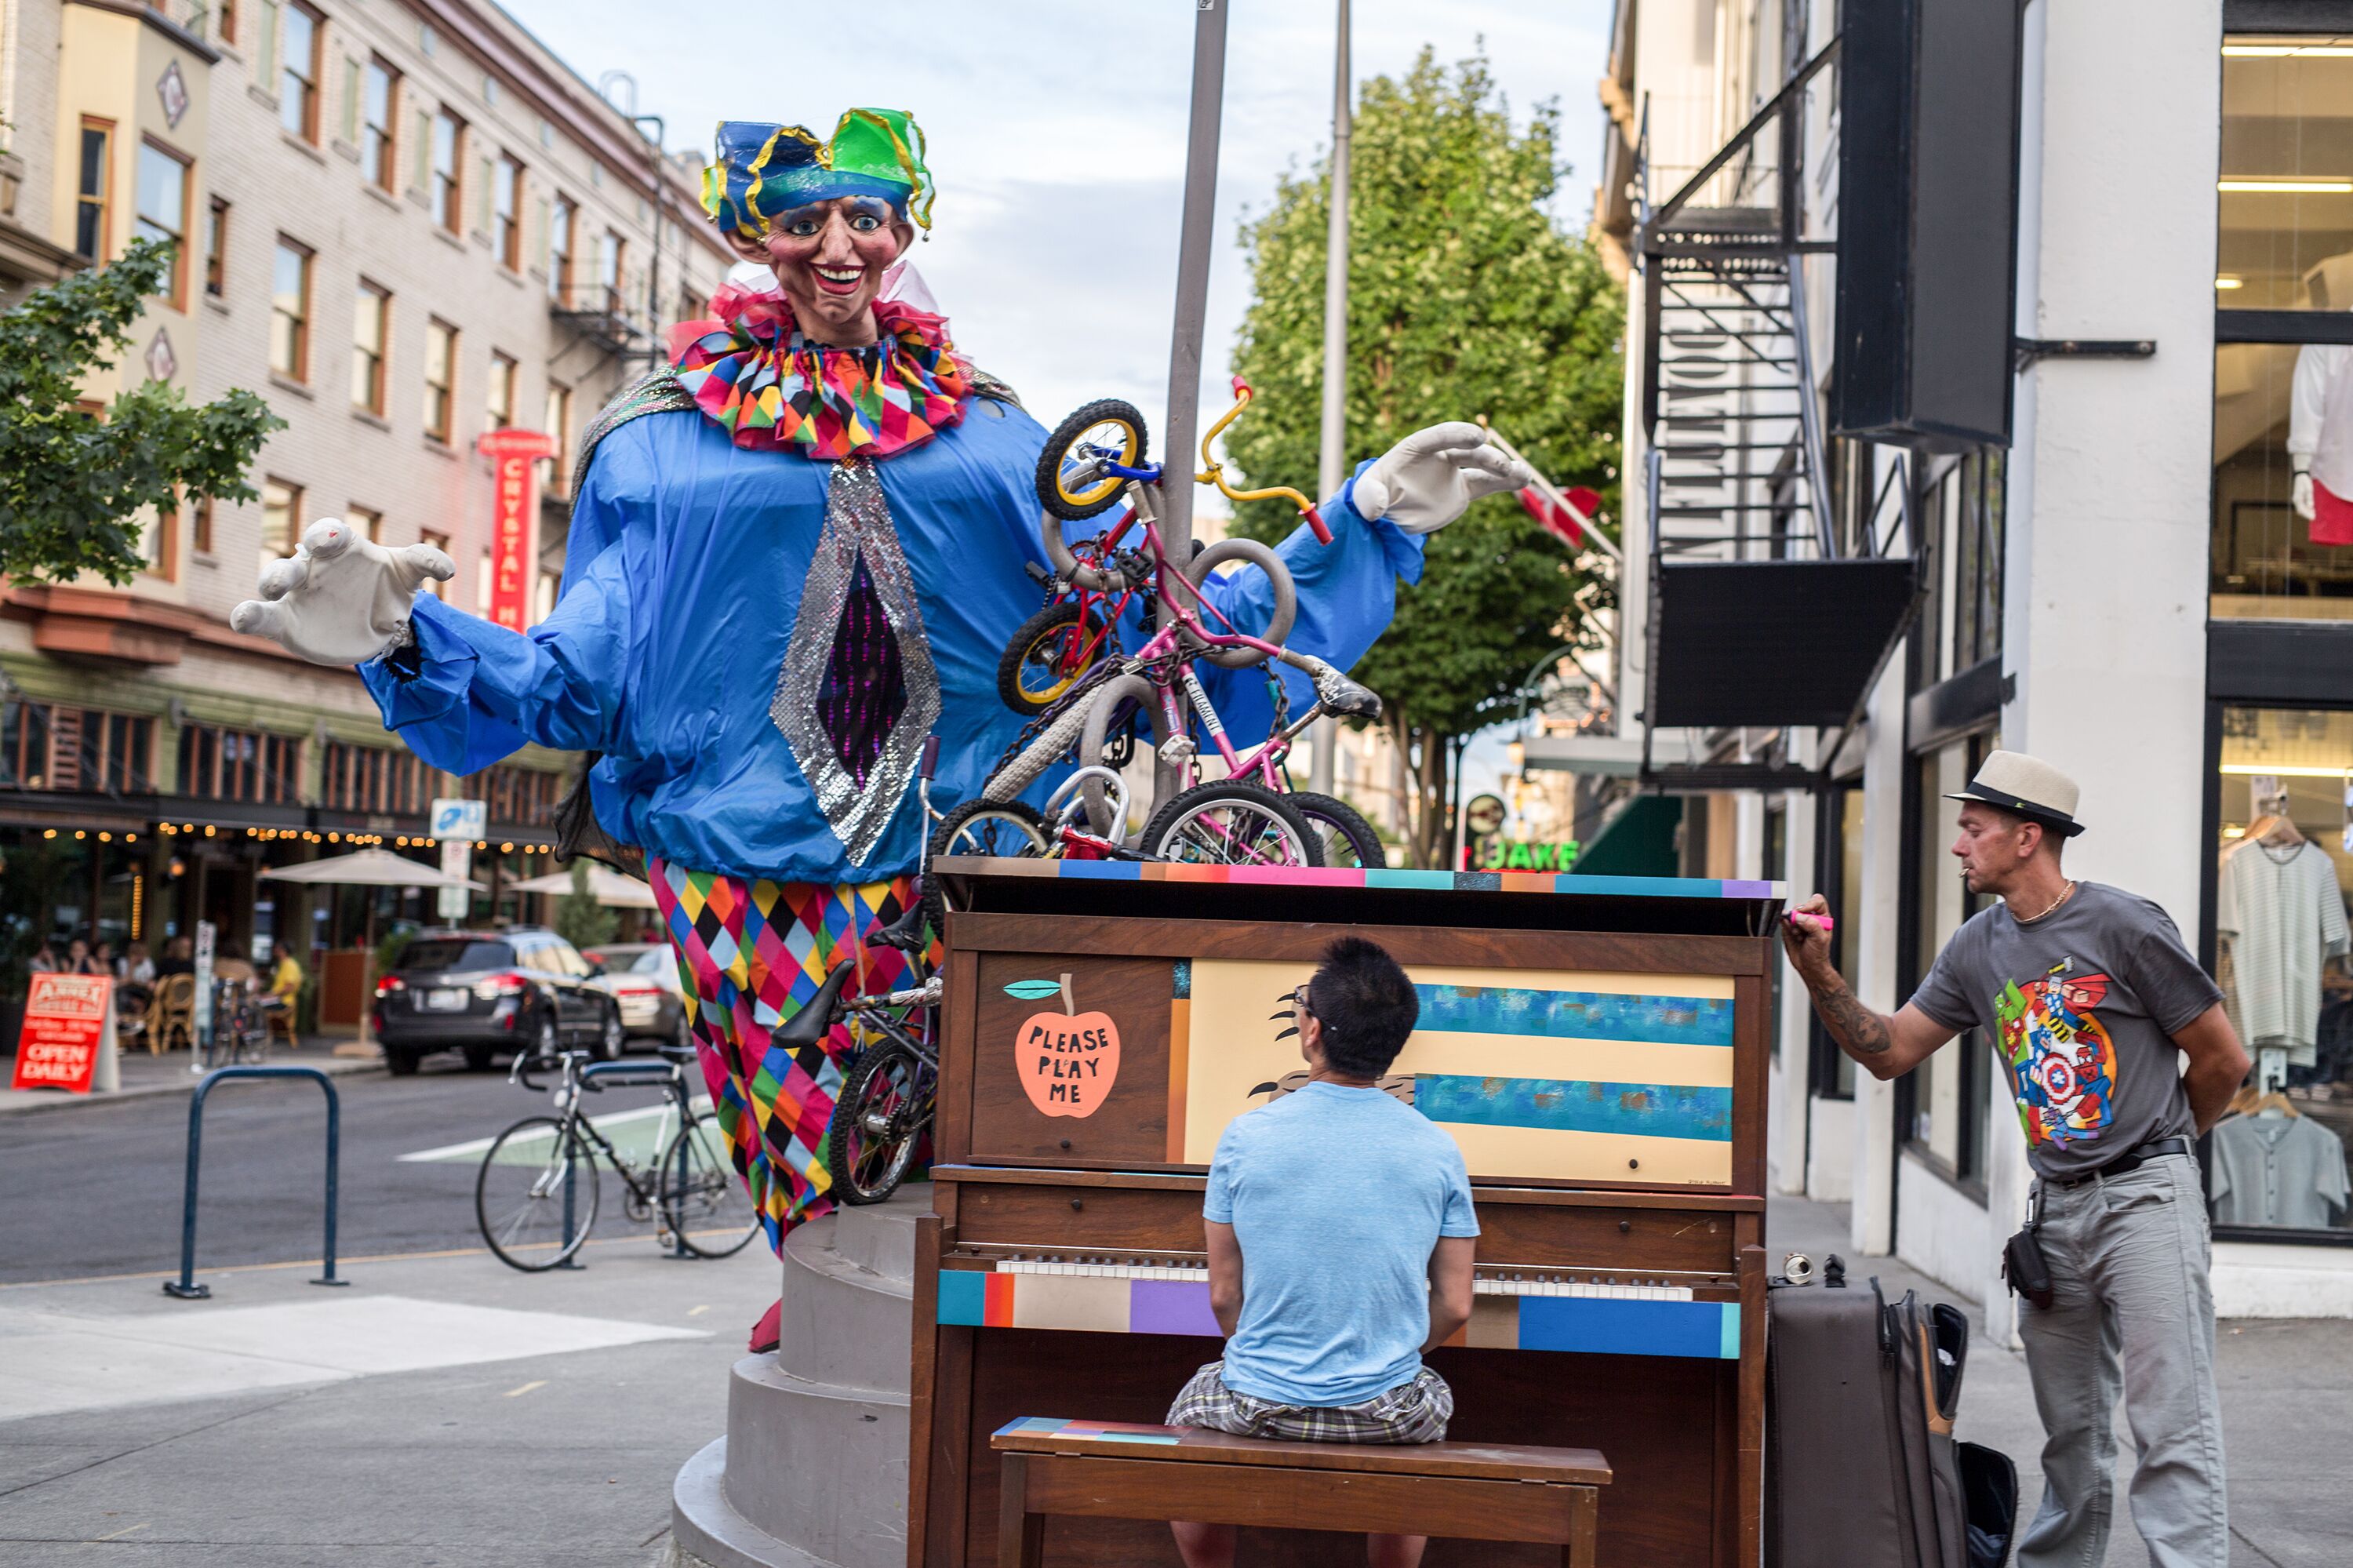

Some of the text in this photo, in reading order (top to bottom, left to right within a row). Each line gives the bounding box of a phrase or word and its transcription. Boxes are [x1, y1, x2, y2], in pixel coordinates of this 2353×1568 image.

[500, 458, 523, 592] CRYSTAL
[1028, 1025, 1108, 1053] PLEASE
[27, 1042, 89, 1062] OPEN
[21, 1060, 88, 1081] DAILY
[1038, 1056, 1100, 1079] PLAY
[1049, 1083, 1081, 1103] ME
